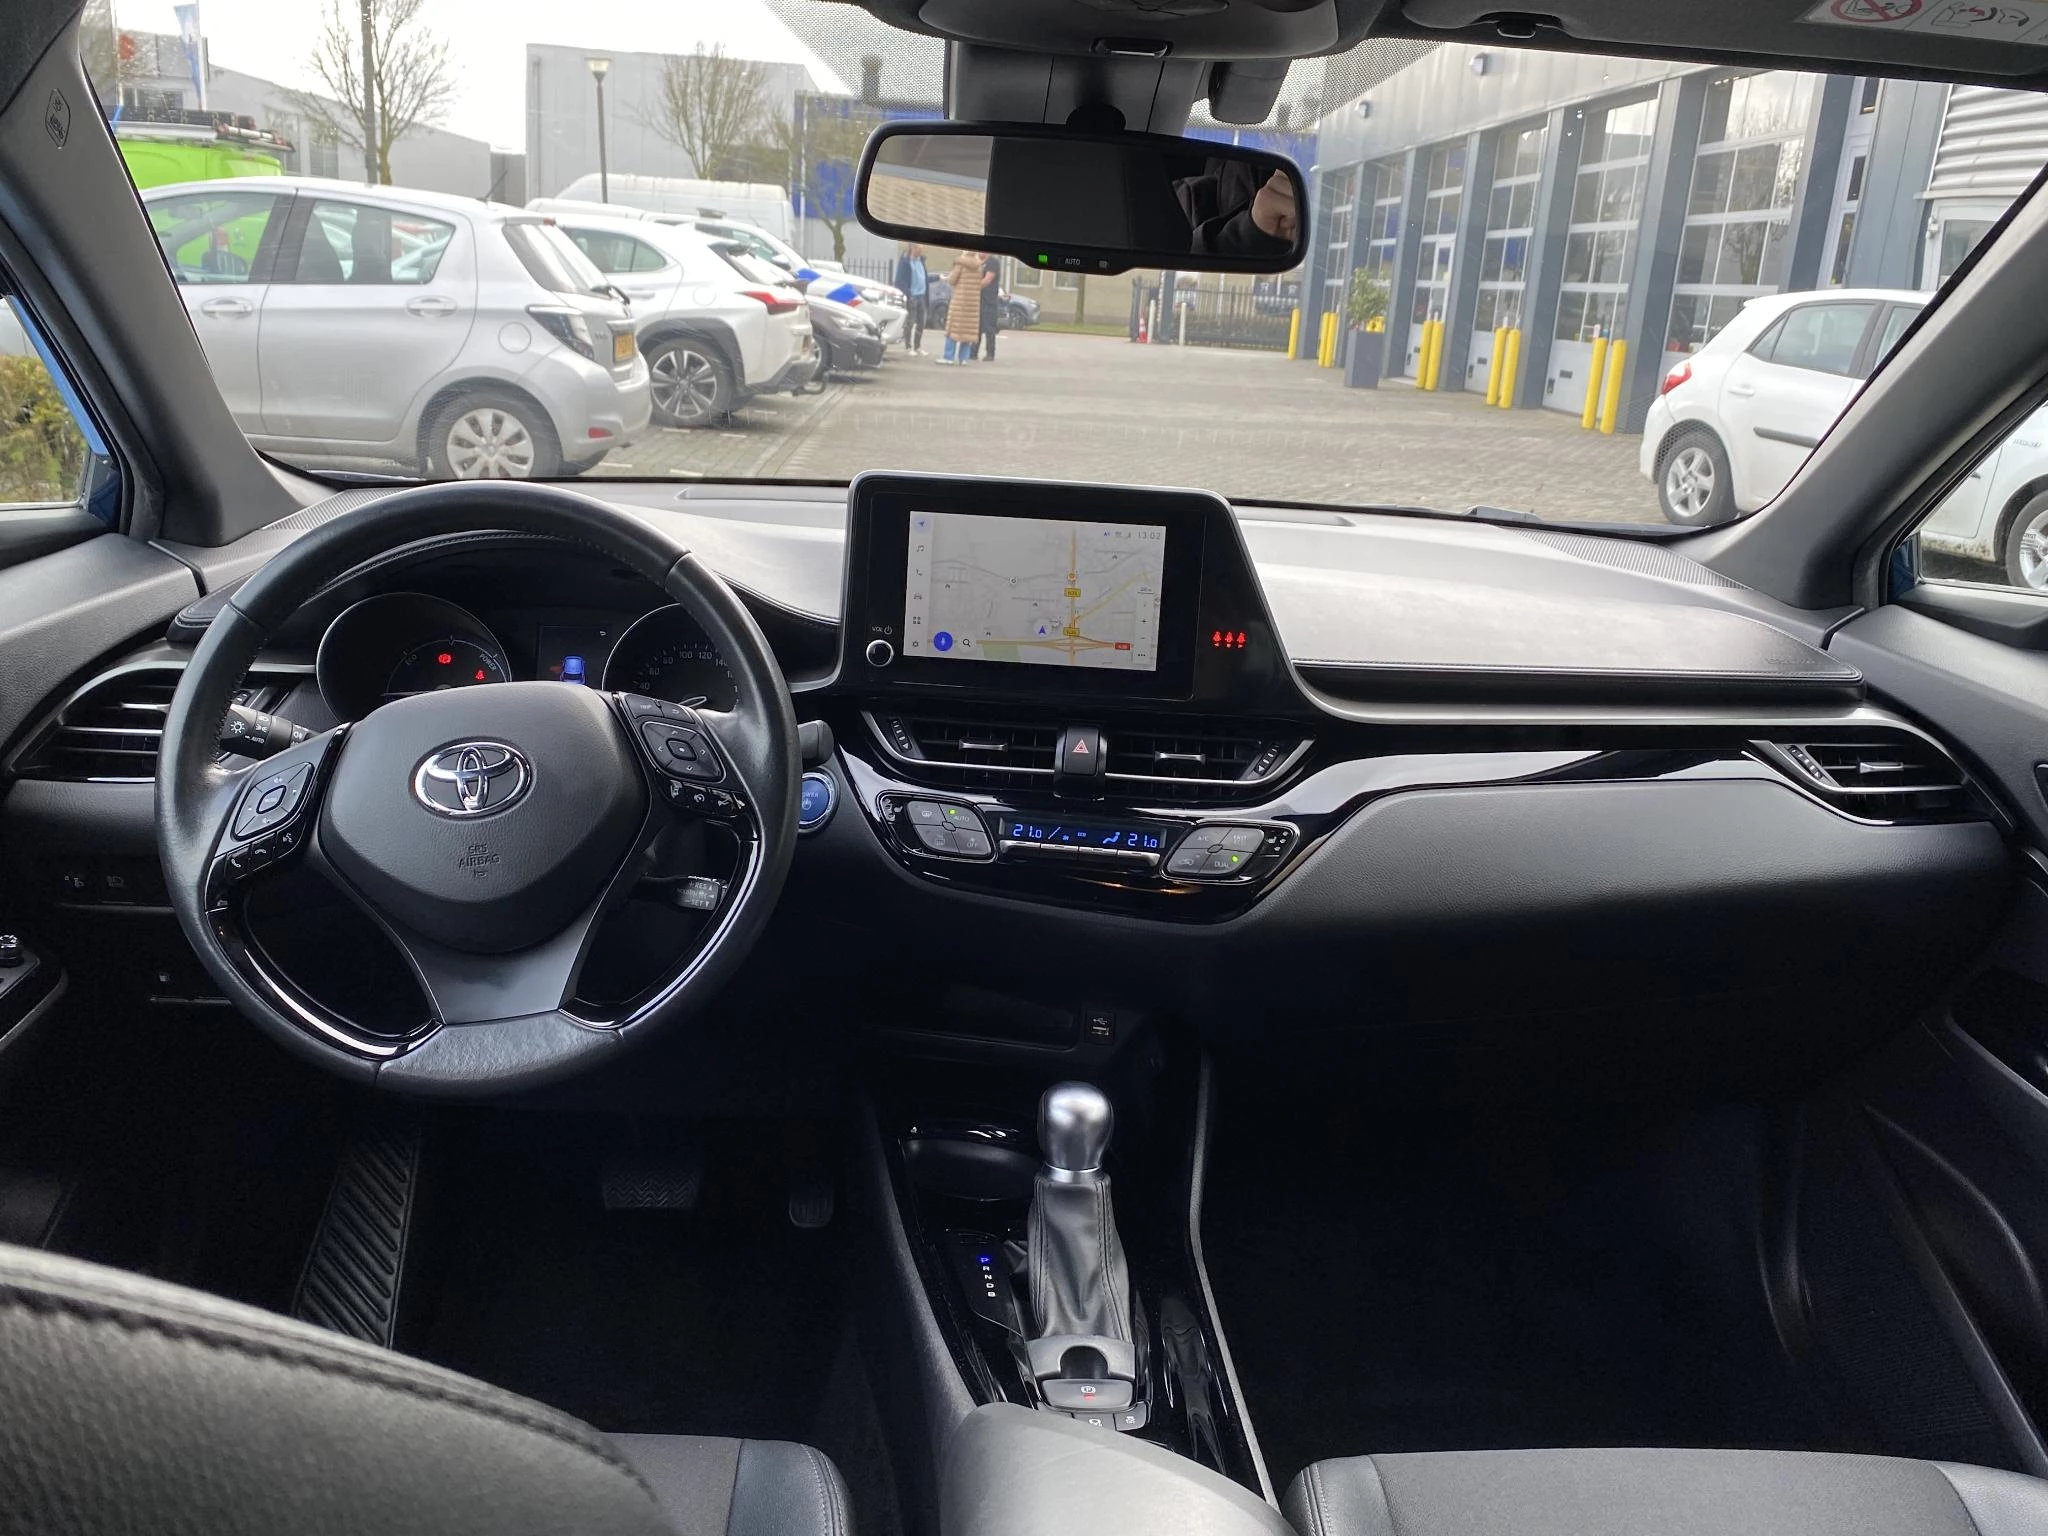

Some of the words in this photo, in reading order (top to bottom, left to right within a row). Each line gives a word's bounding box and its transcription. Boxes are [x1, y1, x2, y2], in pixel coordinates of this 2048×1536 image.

[1065, 258, 1081, 266] AUTO
[680, 651, 693, 659] 100
[699, 651, 713, 660] 120
[479, 653, 497, 671] POWER
[662, 656, 674, 665] 80
[1012, 823, 1043, 839] 21.0
[1127, 833, 1158, 848] 21.0
[458, 854, 501, 869] AIRBAG
[1214, 860, 1229, 868] DUAL
